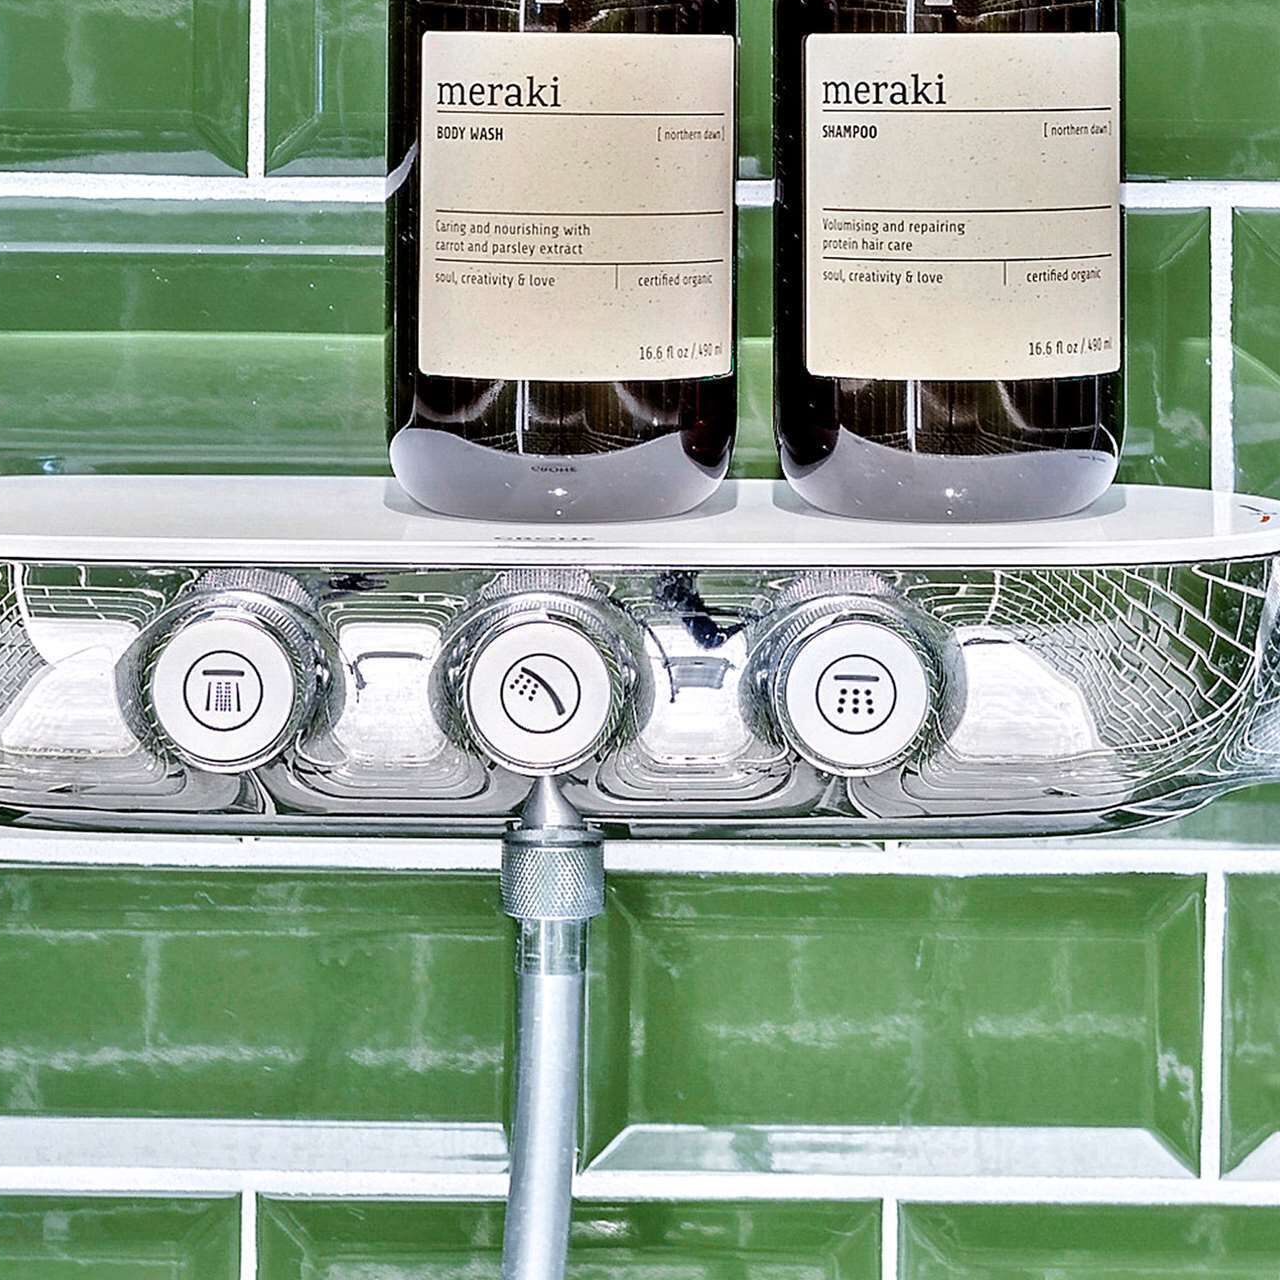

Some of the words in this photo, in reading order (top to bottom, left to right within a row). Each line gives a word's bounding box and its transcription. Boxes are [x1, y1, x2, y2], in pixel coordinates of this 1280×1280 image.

[437, 76, 562, 107] meraki
[822, 74, 947, 105] meraki
[437, 126, 466, 140] BODY
[470, 126, 504, 141] WASH
[665, 128, 701, 140] northern
[822, 125, 877, 139] SHAMPOO
[1051, 123, 1089, 136] northern
[436, 219, 466, 236] Caring
[469, 222, 491, 236] and
[494, 223, 559, 239] nourishing
[563, 224, 590, 236] with
[823, 218, 879, 235] Volumising
[882, 220, 904, 232] and
[909, 220, 965, 235] repairing
[436, 241, 464, 251] carrot
[468, 240, 488, 252] and
[492, 241, 535, 256] parsley
[540, 243, 583, 255] extract
[823, 237, 858, 250] protein
[862, 238, 884, 250] hair
[887, 241, 913, 251] care
[461, 272, 514, 288] creativity
[518, 273, 525, 286] &
[530, 274, 555, 286] love
[638, 271, 680, 286] certified
[682, 272, 712, 287] organic
[849, 270, 902, 286] creativity
[906, 271, 913, 283] &
[917, 271, 943, 283] love
[1027, 269, 1068, 282] certified
[1071, 268, 1101, 283] organic
[640, 346, 663, 360] 16.6
[677, 348, 688, 358] oz
[1029, 342, 1052, 355] 16.6
[1067, 343, 1078, 354] oz
